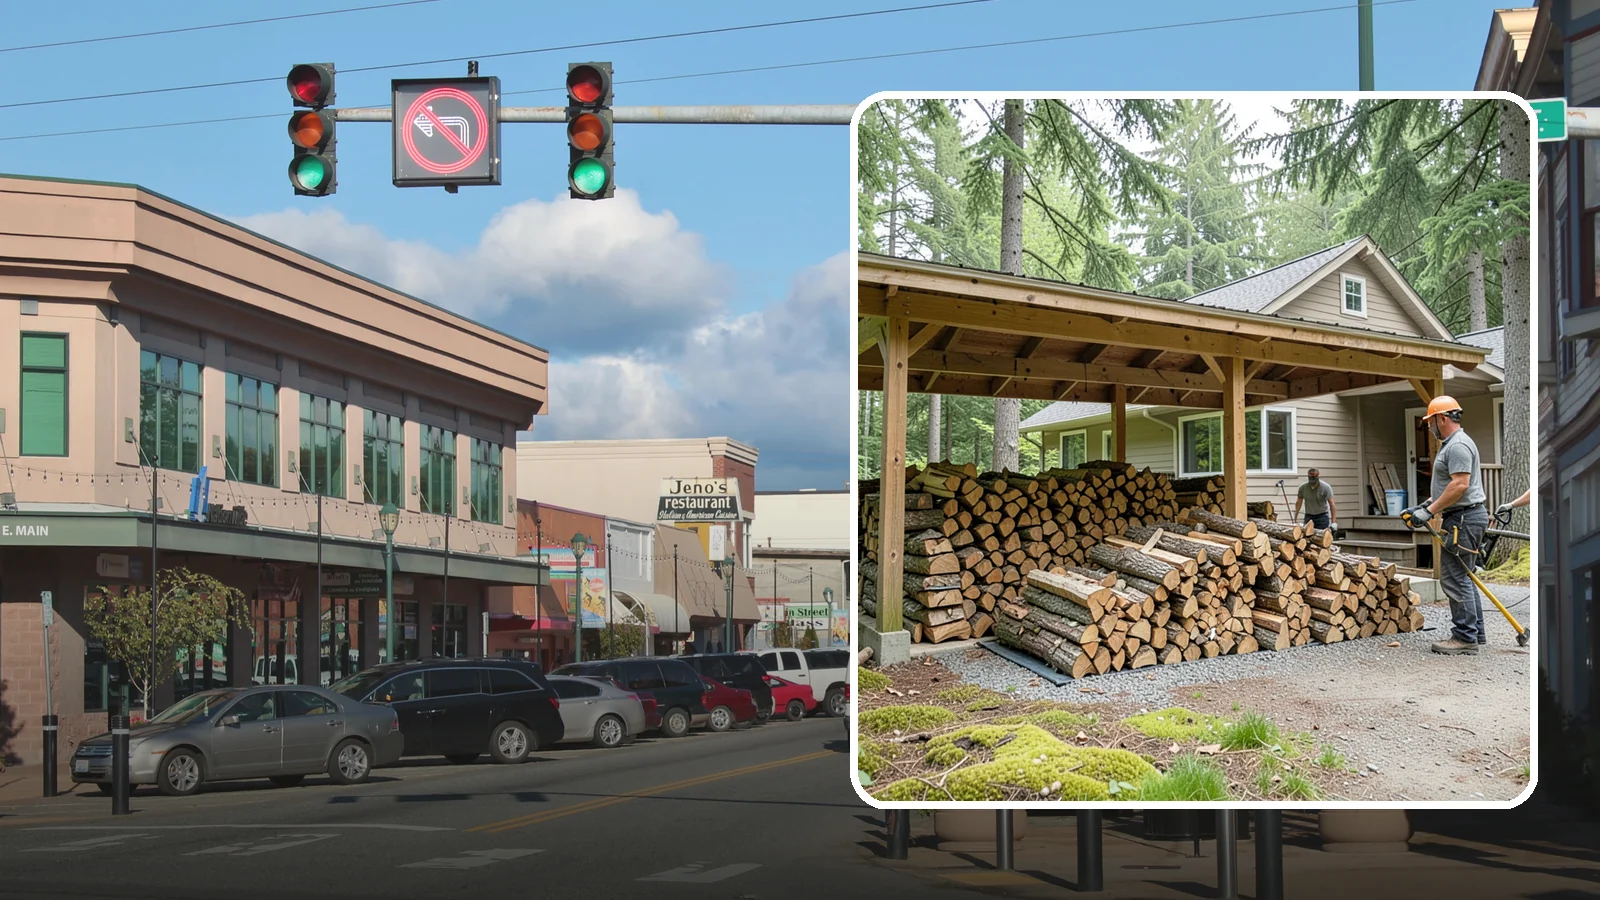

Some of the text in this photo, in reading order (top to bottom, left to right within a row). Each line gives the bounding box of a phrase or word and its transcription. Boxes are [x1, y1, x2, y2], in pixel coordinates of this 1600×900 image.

[670, 480, 727, 494] Jeno's
[665, 497, 731, 509] restaurant
[658, 510, 681, 520] Italian
[685, 509, 715, 519] American
[714, 509, 737, 519] Cuisine
[2, 525, 49, 536] E. MAIN
[797, 607, 828, 617] Street
